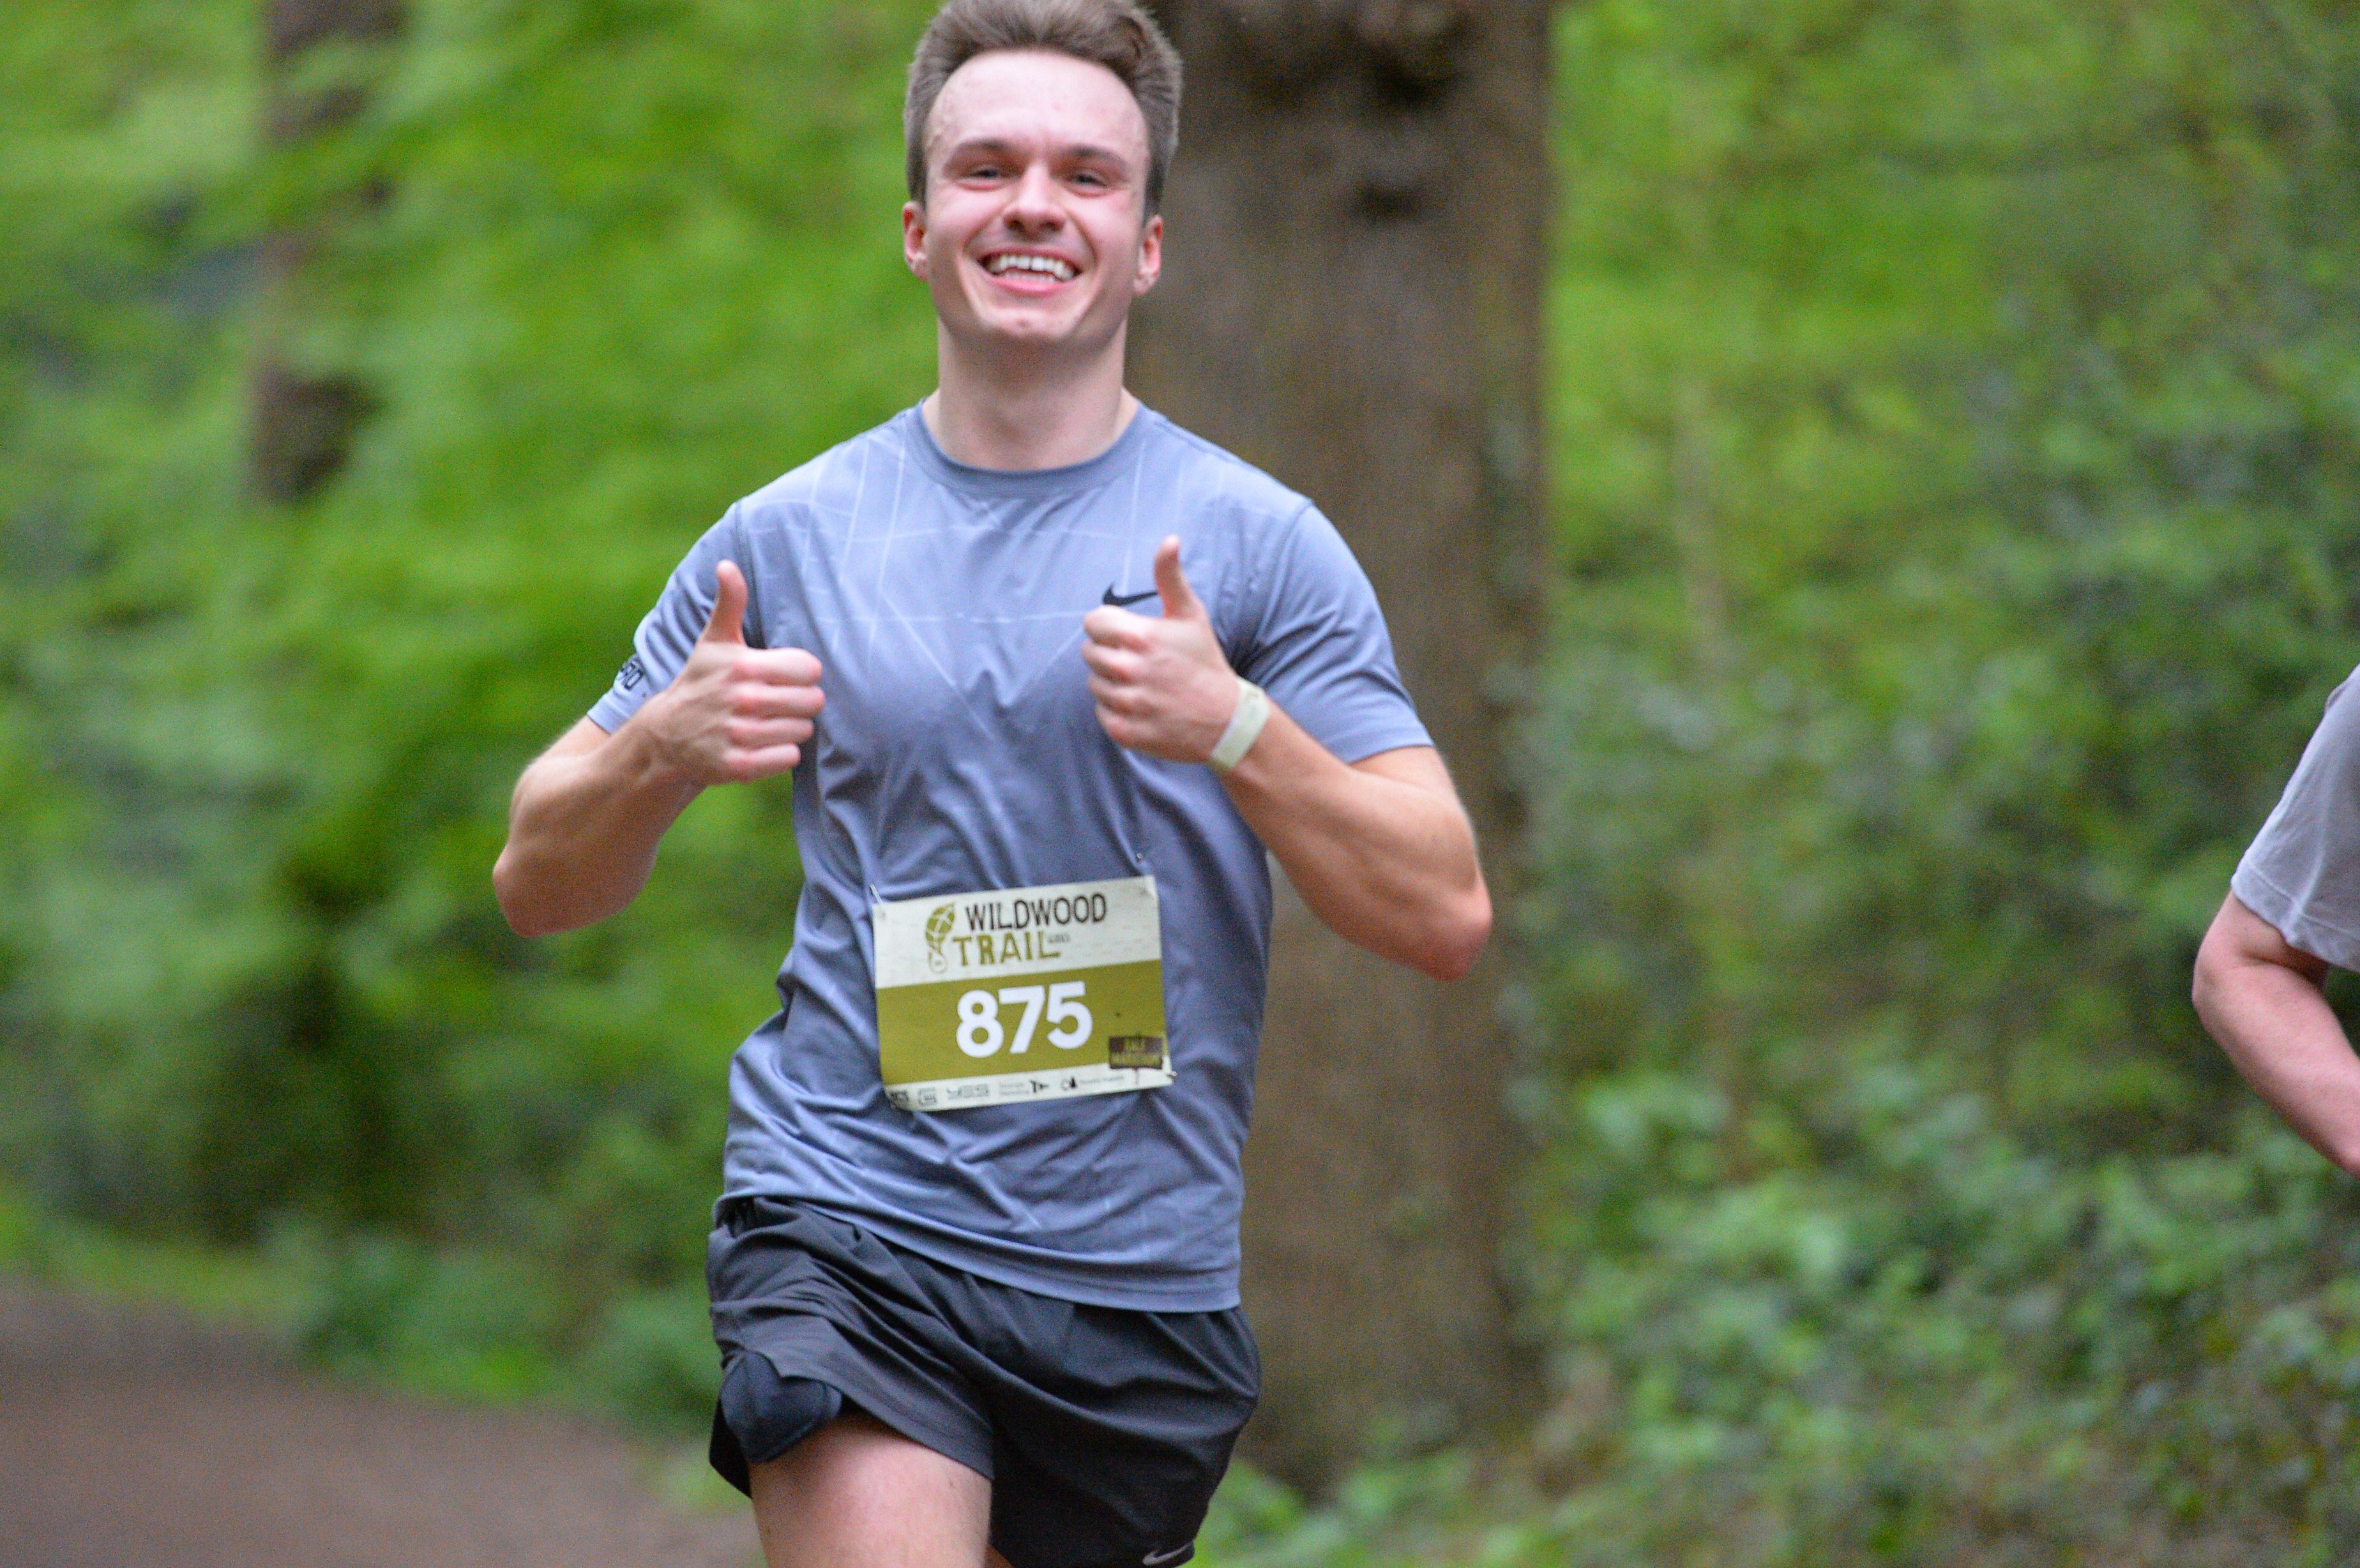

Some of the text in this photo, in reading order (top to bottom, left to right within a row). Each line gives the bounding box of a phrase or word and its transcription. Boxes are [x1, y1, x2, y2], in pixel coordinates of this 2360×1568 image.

[965, 893, 1107, 931] WILDWOOD
[952, 930, 1061, 966] TRAIL
[956, 981, 1093, 1058] 875
